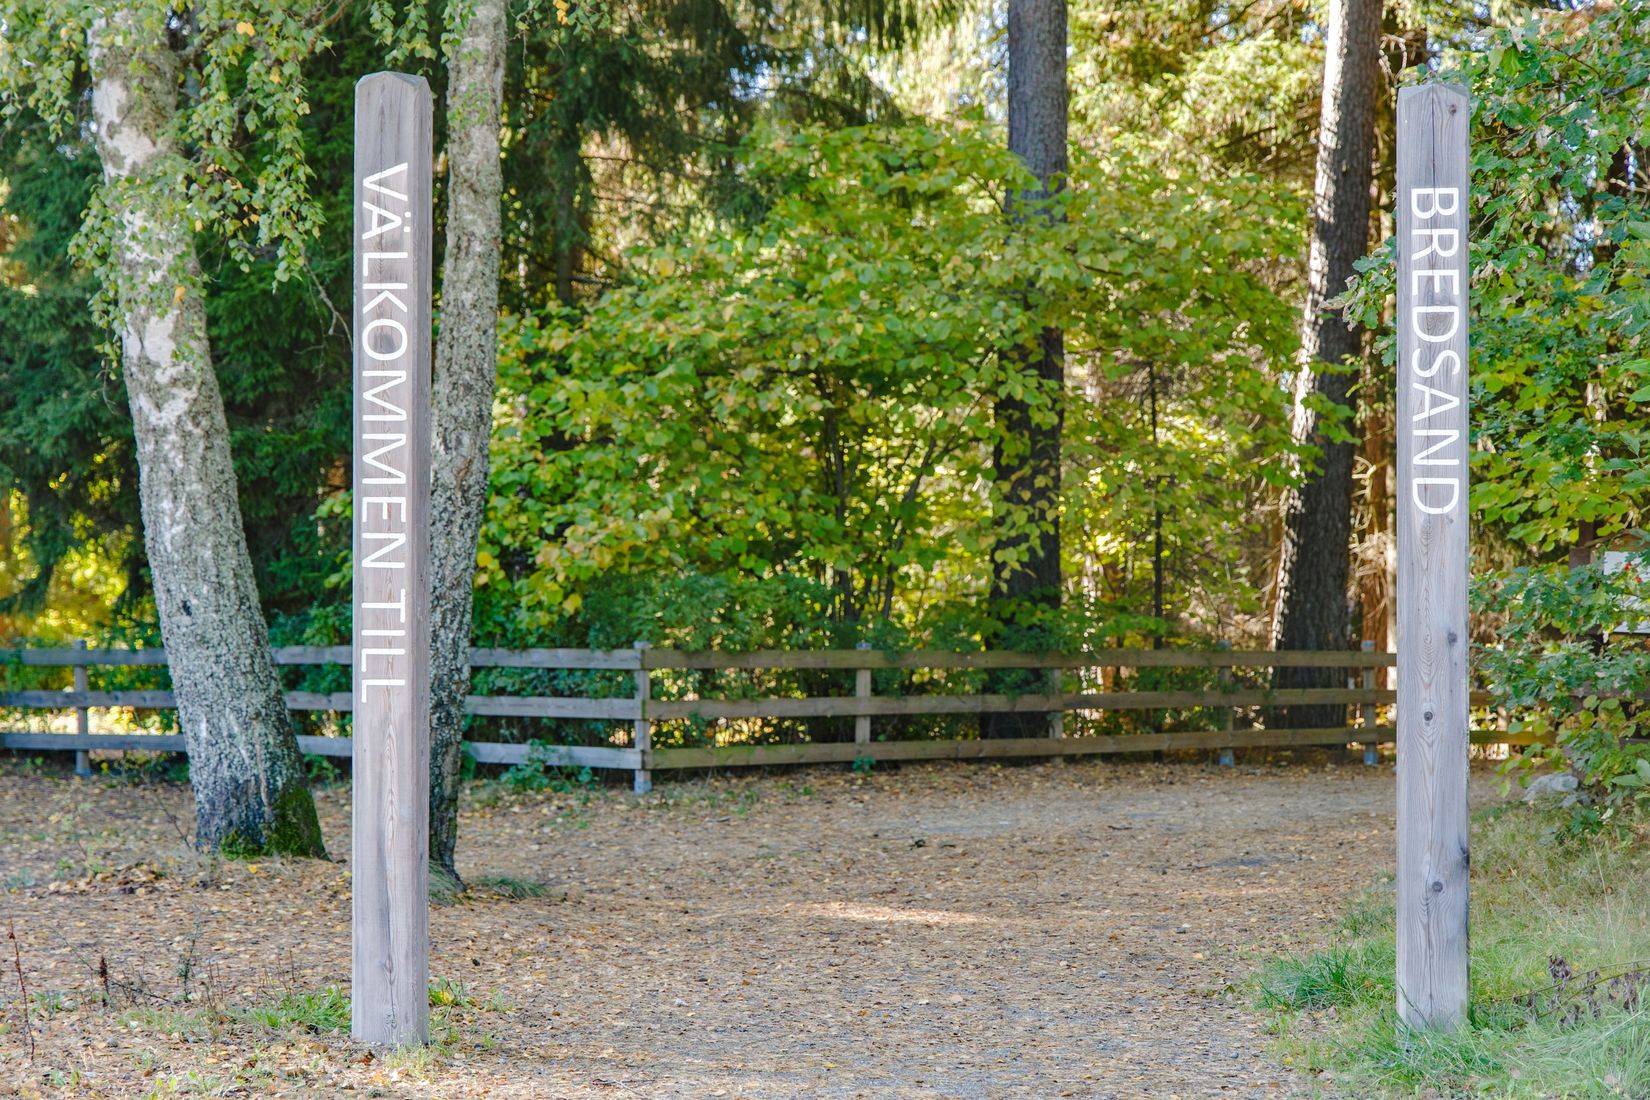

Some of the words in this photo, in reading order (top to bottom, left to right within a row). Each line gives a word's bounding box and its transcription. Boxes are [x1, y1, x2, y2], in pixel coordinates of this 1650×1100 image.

[362, 162, 411, 568] VÄLKOMMEN
[1411, 187, 1460, 514] BREDSAND
[361, 588, 405, 703] TILL
